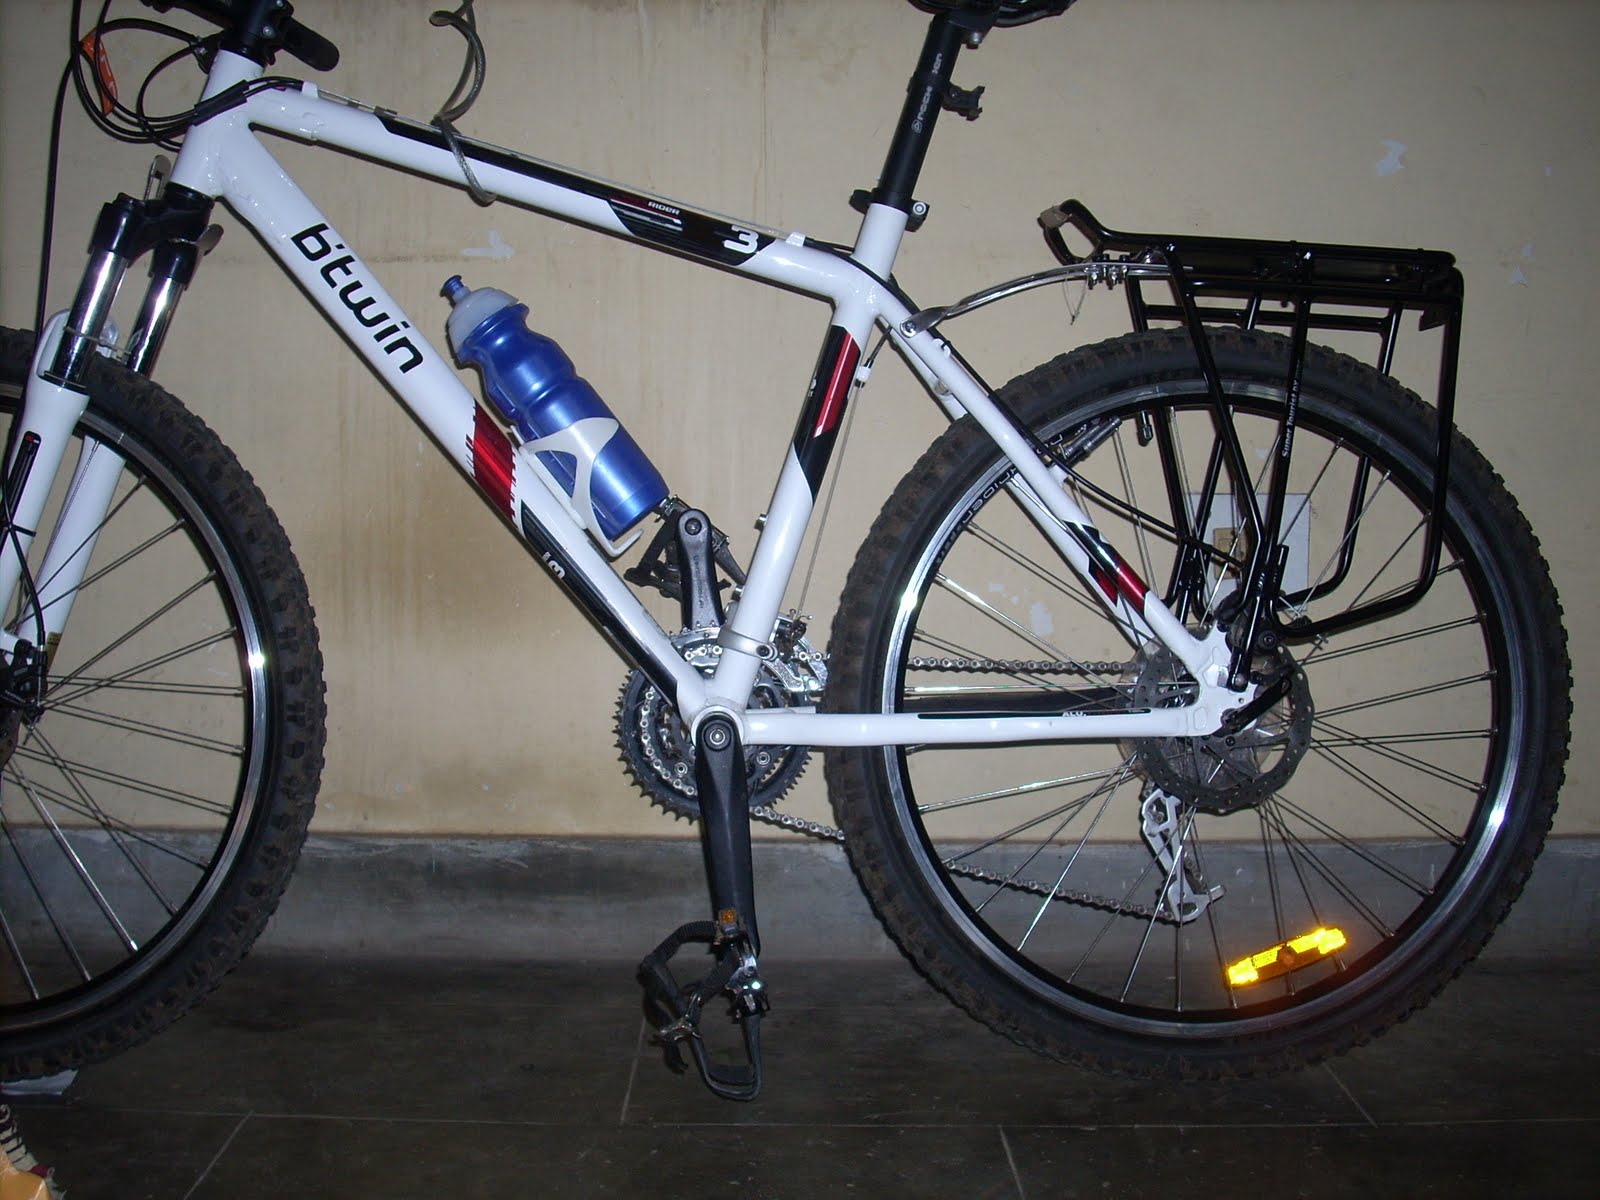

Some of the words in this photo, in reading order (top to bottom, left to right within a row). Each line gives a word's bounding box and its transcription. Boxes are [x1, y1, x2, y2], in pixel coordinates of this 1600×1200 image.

[723, 225, 759, 254] 3
[1286, 393, 1298, 426] Tourist
[1282, 428, 1292, 458] Super
